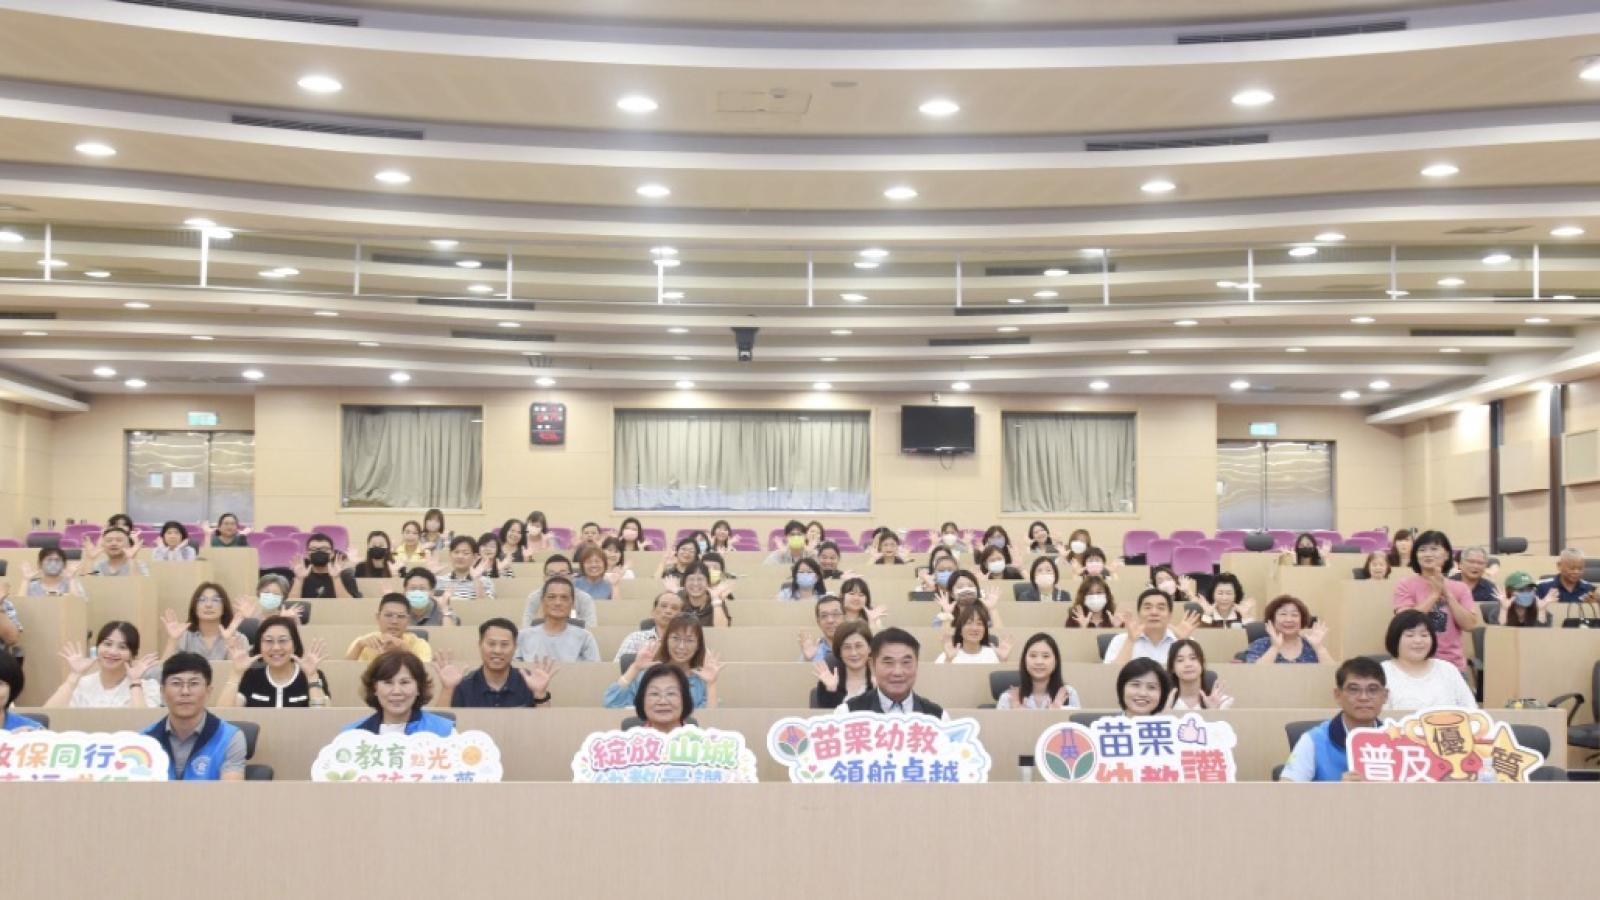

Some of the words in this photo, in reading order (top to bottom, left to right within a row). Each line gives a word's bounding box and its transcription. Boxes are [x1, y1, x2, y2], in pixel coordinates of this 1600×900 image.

[592, 736, 738, 768] 綻放山城
[811, 721, 939, 760] 苗栗幼教
[1098, 721, 1174, 757] 苗栗
[1360, 743, 1436, 782] 普及
[1433, 727, 1466, 756] 優
[829, 757, 959, 782] 領航卓越
